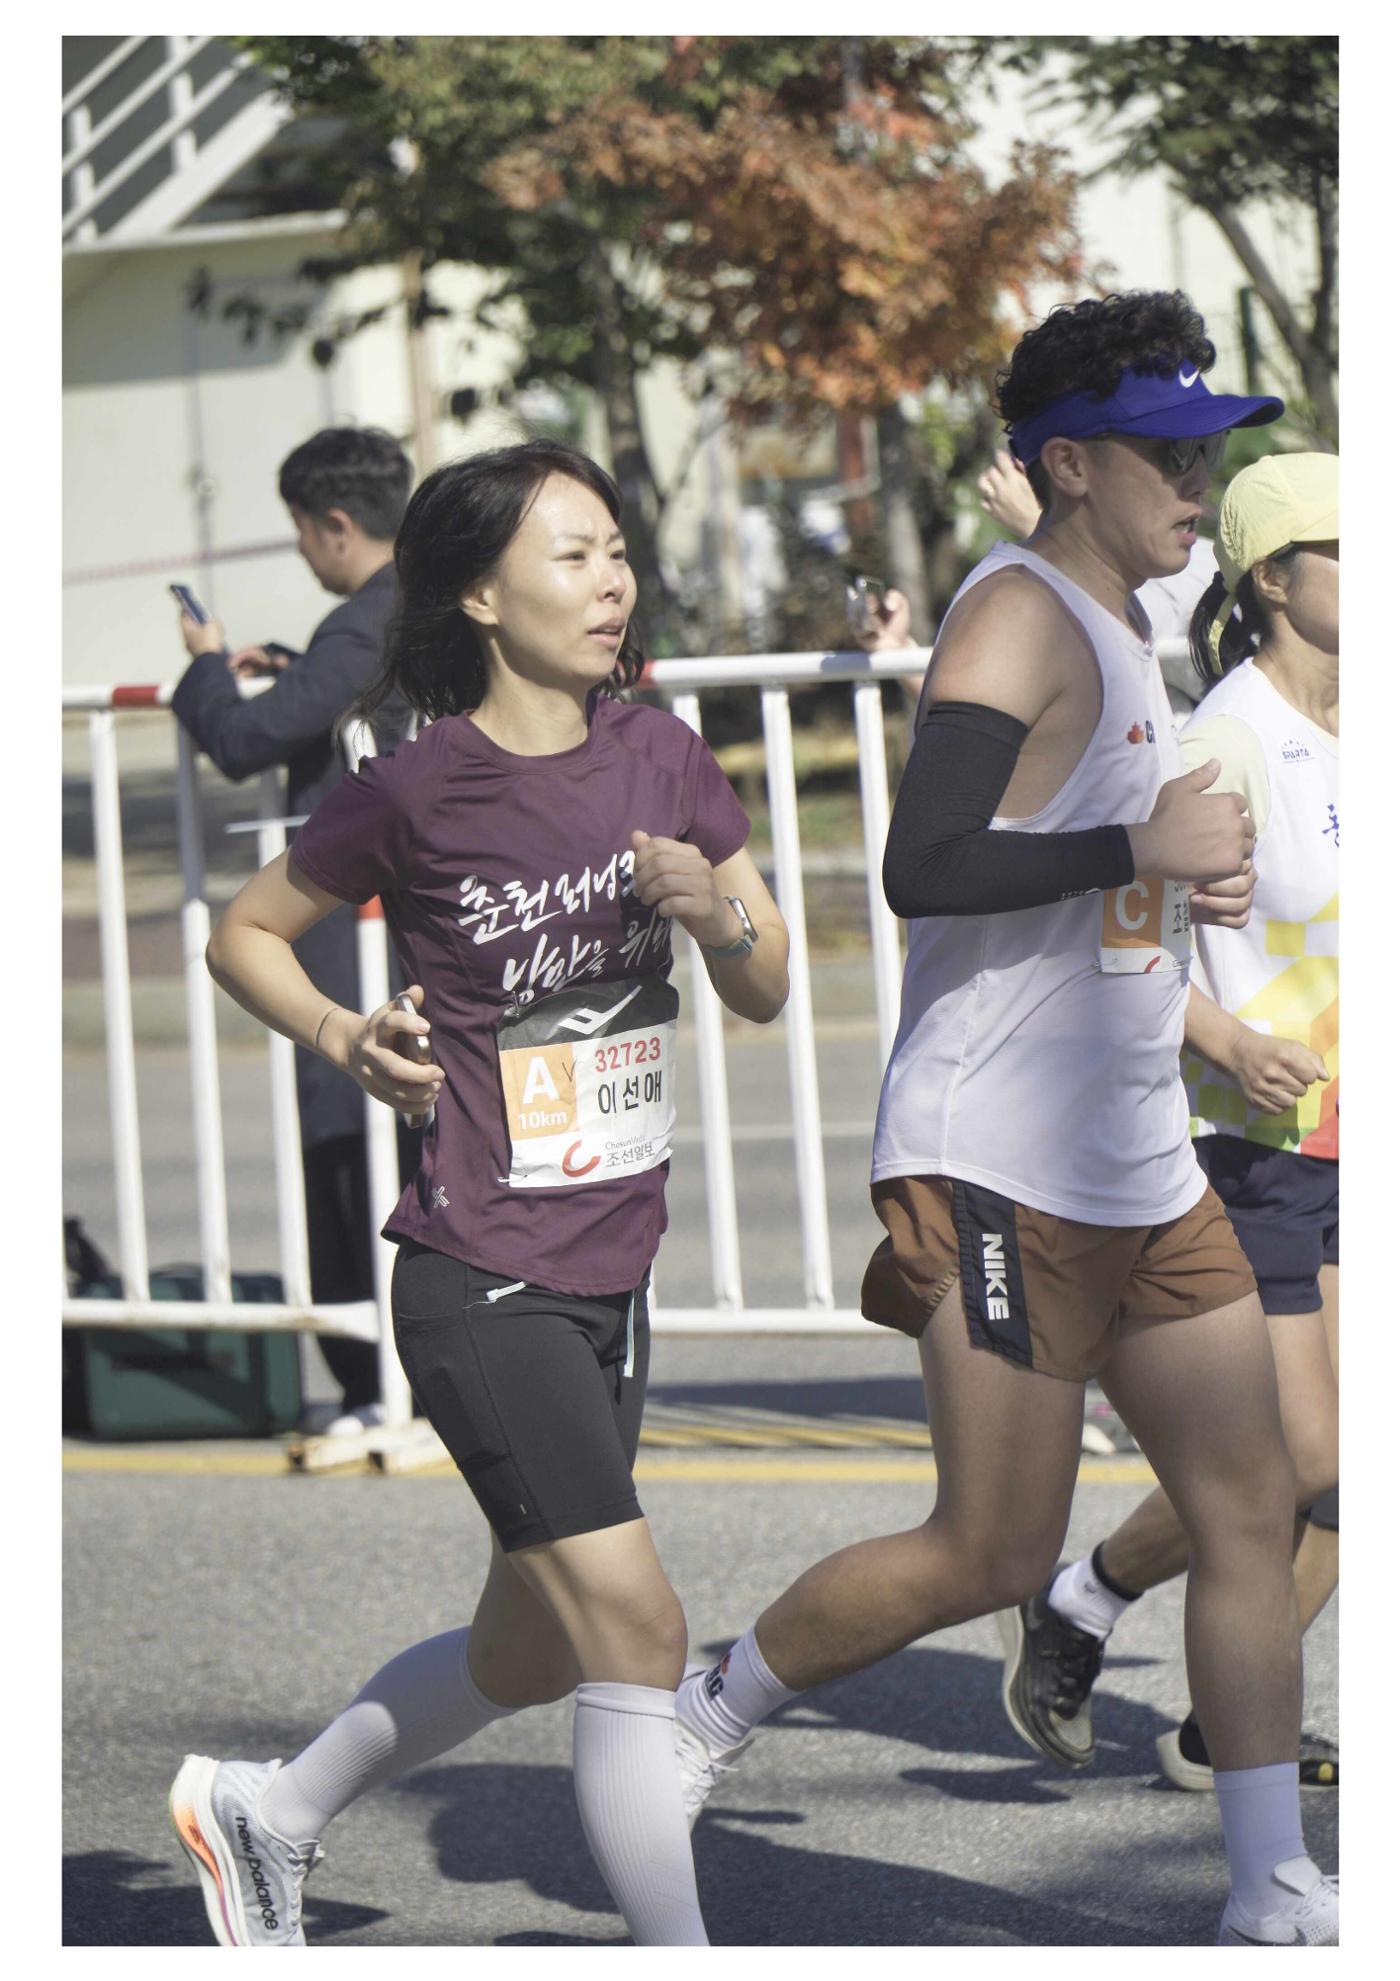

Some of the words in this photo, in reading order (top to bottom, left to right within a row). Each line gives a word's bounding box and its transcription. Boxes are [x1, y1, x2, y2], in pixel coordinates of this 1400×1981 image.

[1282, 748, 1310, 760] SPARTA
[457, 874, 564, 945] 춘천
[1115, 880, 1150, 931] C
[595, 1037, 661, 1073] 32723
[522, 1056, 561, 1105] A
[597, 1070, 662, 1114] 이선애
[518, 1110, 567, 1130] 10km
[605, 1142, 656, 1168] 조선일보
[982, 1233, 1009, 1320] NIKE
[235, 1816, 256, 1856] new
[248, 1858, 279, 1931] balance
